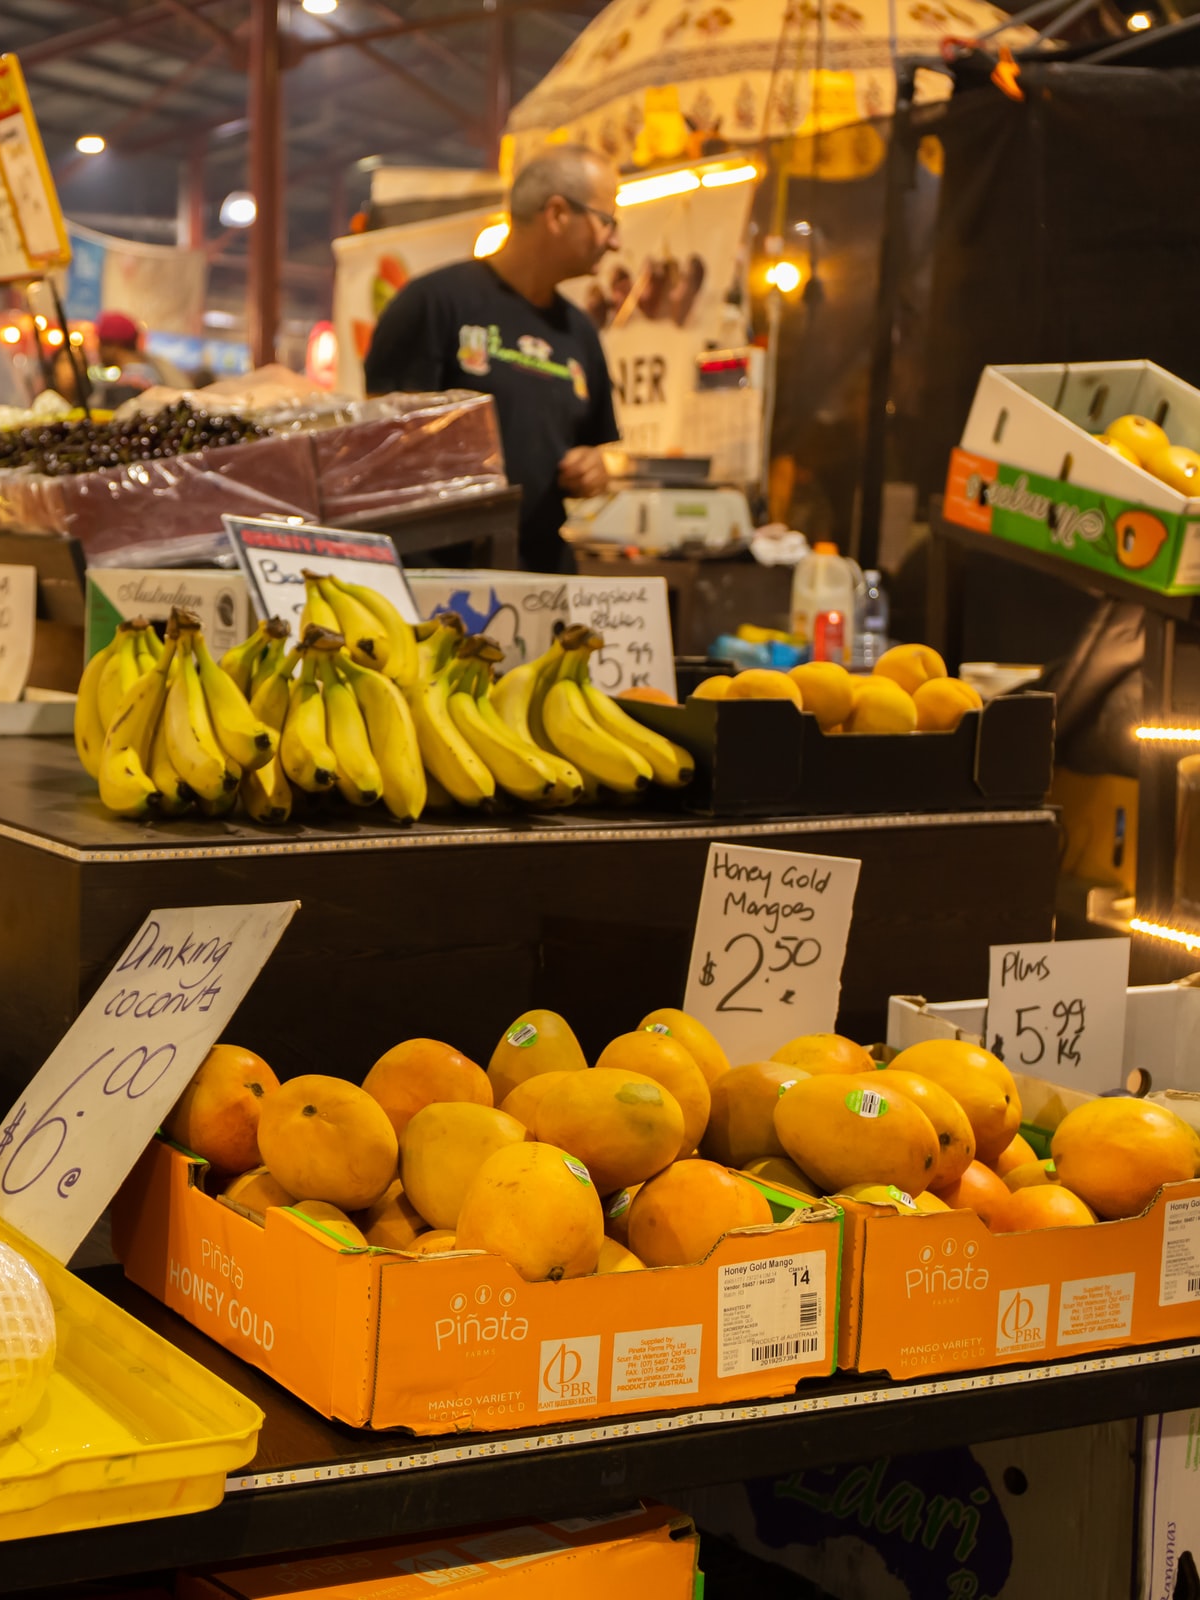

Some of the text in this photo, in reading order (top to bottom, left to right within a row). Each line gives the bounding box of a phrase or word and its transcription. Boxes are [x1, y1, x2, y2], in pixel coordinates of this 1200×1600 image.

[712, 852, 832, 899] Honey Gold
[723, 891, 815, 934] Mangoes
[116, 921, 233, 989] Drinking
[104, 973, 223, 1018] coconuts
[1170, 1202, 1189, 1211] Honey
[201, 1237, 244, 1291] Piñata
[724, 1259, 794, 1276] Honey Gold Mango
[792, 1270, 810, 1287] 14
[905, 1262, 990, 1299] Piñata
[169, 1258, 275, 1351] HONEY GOLD
[434, 1310, 529, 1352] Piñata
[752, 1336, 779, 1346] PRODUCT
[787, 1331, 818, 1340] AUSTRALIA
[1015, 1327, 1042, 1343] PBR
[465, 1348, 497, 1359] FARMS
[901, 1337, 983, 1356] MANGO VARIETY
[901, 1348, 985, 1367] HONEY GOLD
[560, 1381, 593, 1399] PBR
[617, 1382, 647, 1392] PRODUCT
[658, 1377, 694, 1387] AUSTRALIA
[428, 1391, 521, 1412] MANGO VARIETY
[487, 1402, 526, 1416] GOLD
